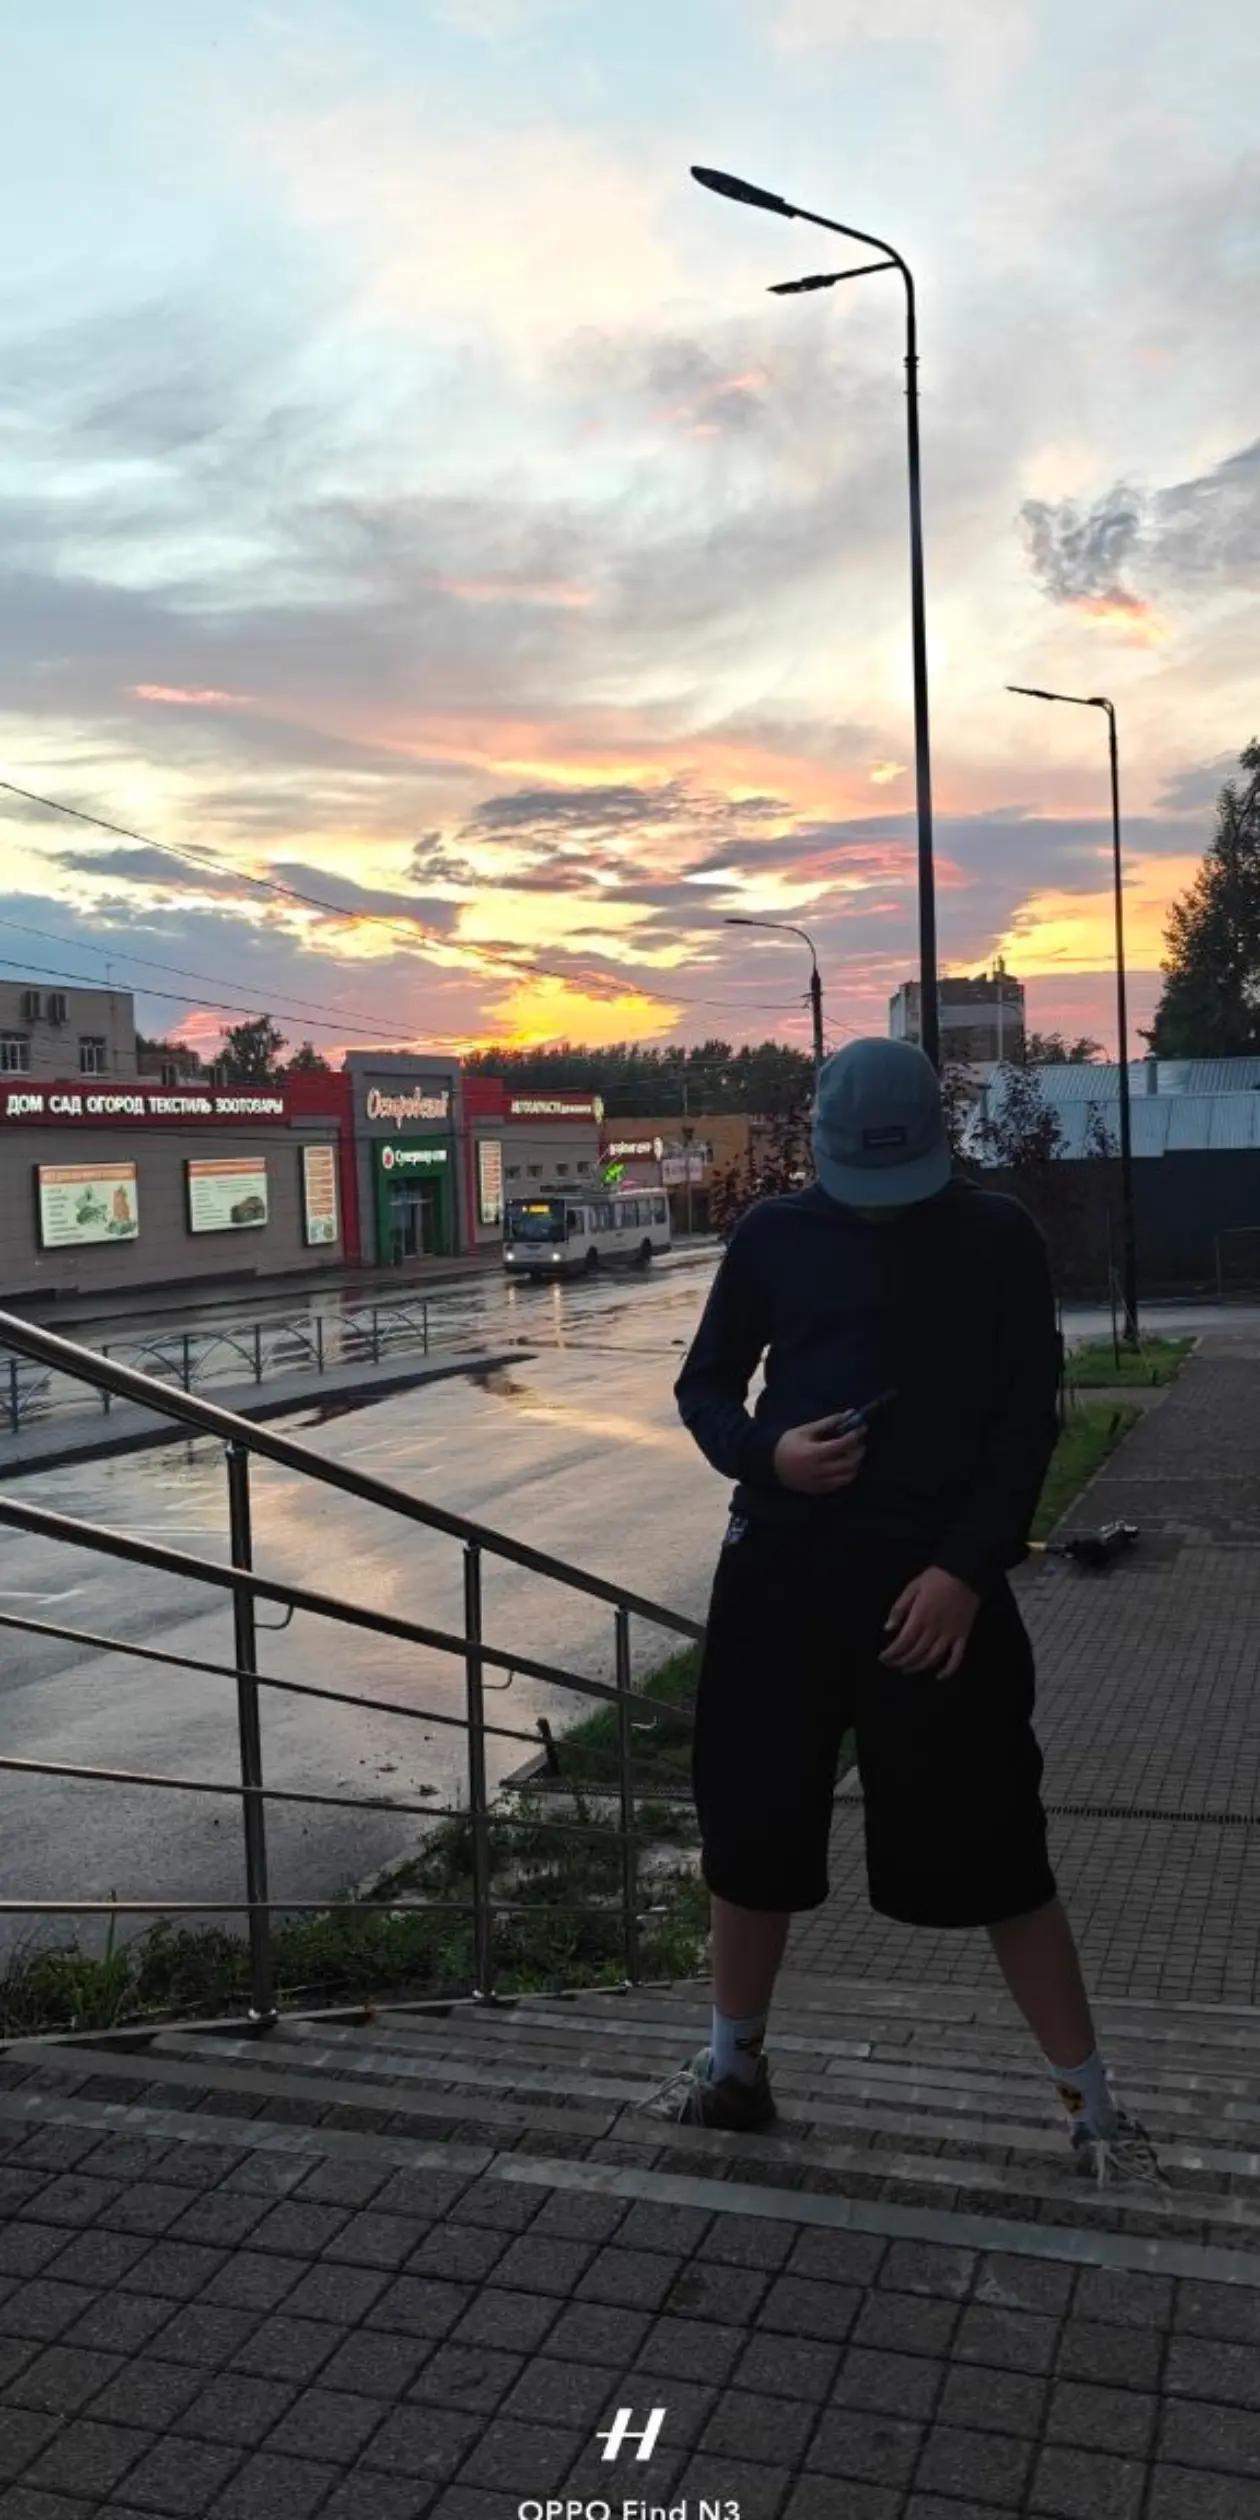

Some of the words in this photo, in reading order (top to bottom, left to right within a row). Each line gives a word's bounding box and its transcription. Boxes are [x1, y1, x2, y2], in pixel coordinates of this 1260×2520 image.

[7, 1094, 43, 1115] ДОМ
[49, 1095, 82, 1115] САД
[86, 1095, 145, 1115] ОГОРОД
[148, 1097, 212, 1114] ТЕКСТИЛЬ
[215, 1097, 284, 1114] ЗООТОВАРЫ
